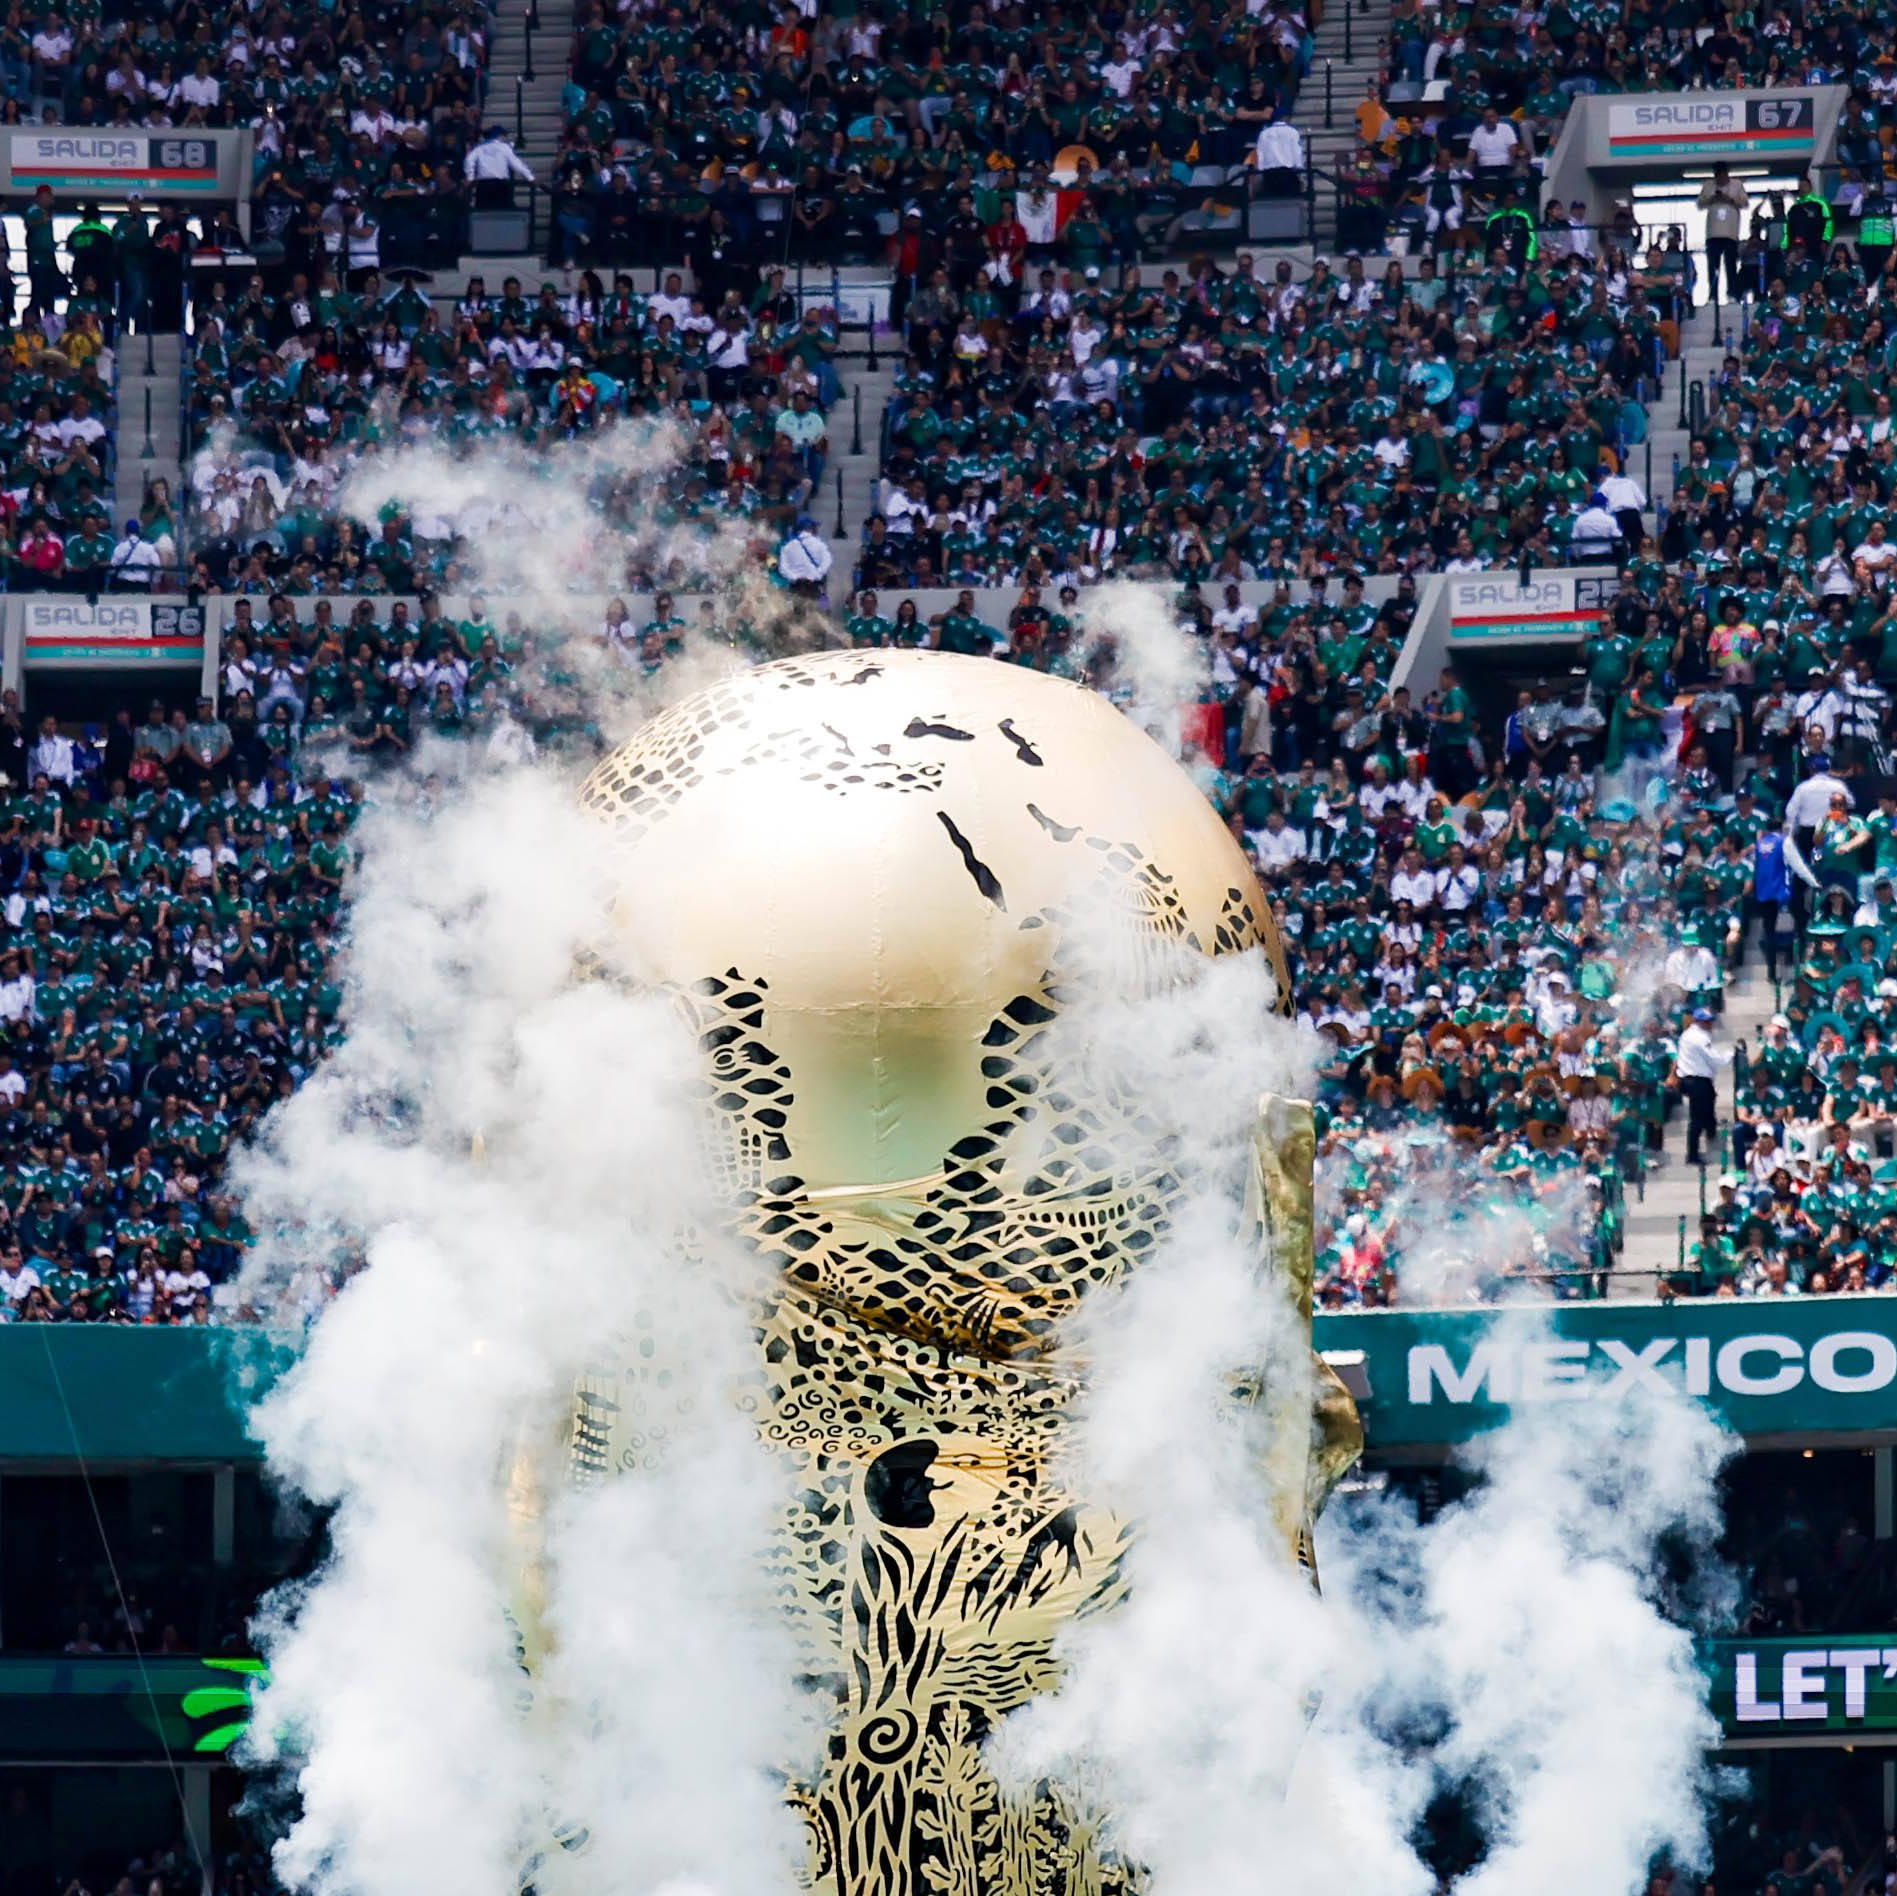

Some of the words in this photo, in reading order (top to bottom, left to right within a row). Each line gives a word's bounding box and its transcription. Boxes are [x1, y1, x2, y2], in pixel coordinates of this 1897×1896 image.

[1635, 104, 1734, 125] SALIDA
[1758, 101, 1803, 129] 67
[38, 139, 138, 158] SALIDA
[161, 141, 205, 168] 68
[1459, 582, 1563, 606] SALIDA
[33, 607, 140, 626] SALIDA
[154, 607, 201, 636] 26
